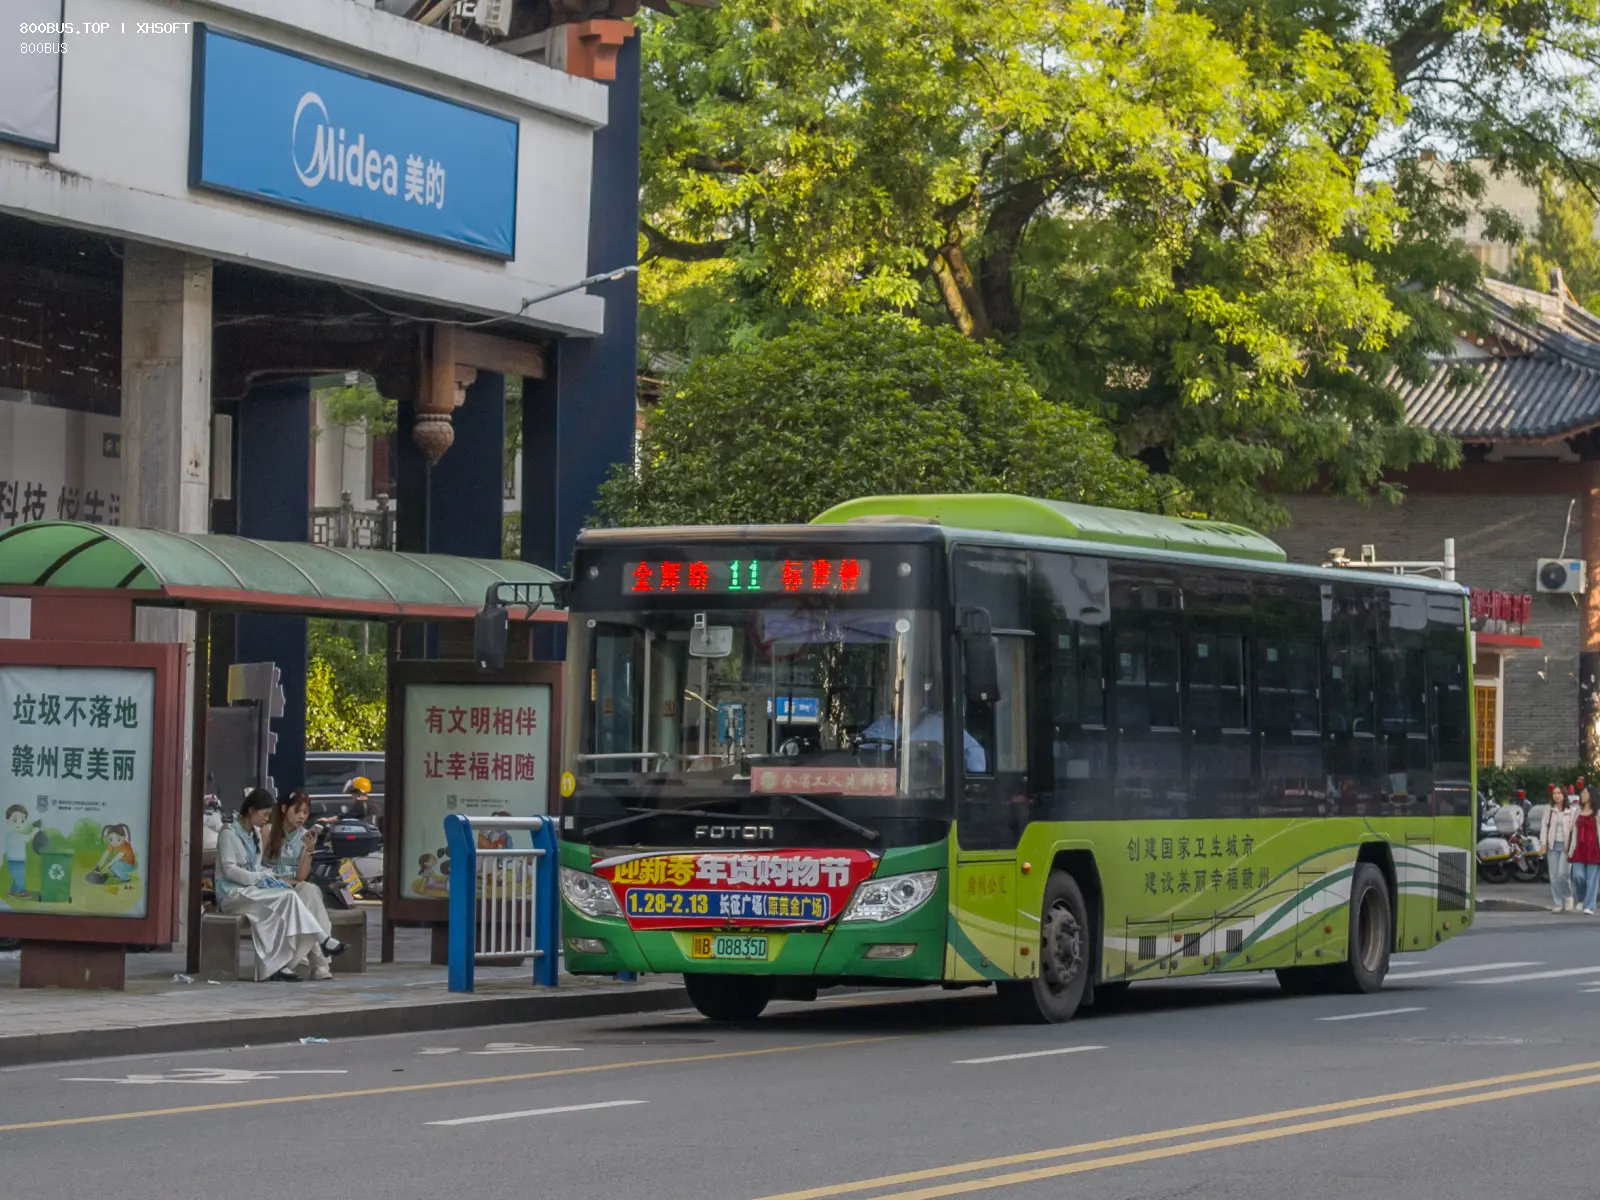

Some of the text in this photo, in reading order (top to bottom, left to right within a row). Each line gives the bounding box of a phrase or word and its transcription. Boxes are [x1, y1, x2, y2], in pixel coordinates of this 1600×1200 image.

[293, 92, 446, 210] Midea 美的
[57, 485, 120, 526] 悦生
[728, 559, 761, 590] 11
[13, 692, 138, 729] 垃圾不落地
[424, 705, 537, 736] 有文明相伴
[11, 744, 136, 781] 赣州更美丽
[423, 751, 536, 781] 让幸福相随
[695, 825, 774, 839] FOTON
[1127, 833, 1255, 862] 创建国家卫生城市
[1144, 866, 1270, 895] 建设美丽幸福赣州
[628, 893, 709, 915] 1.28-2.13
